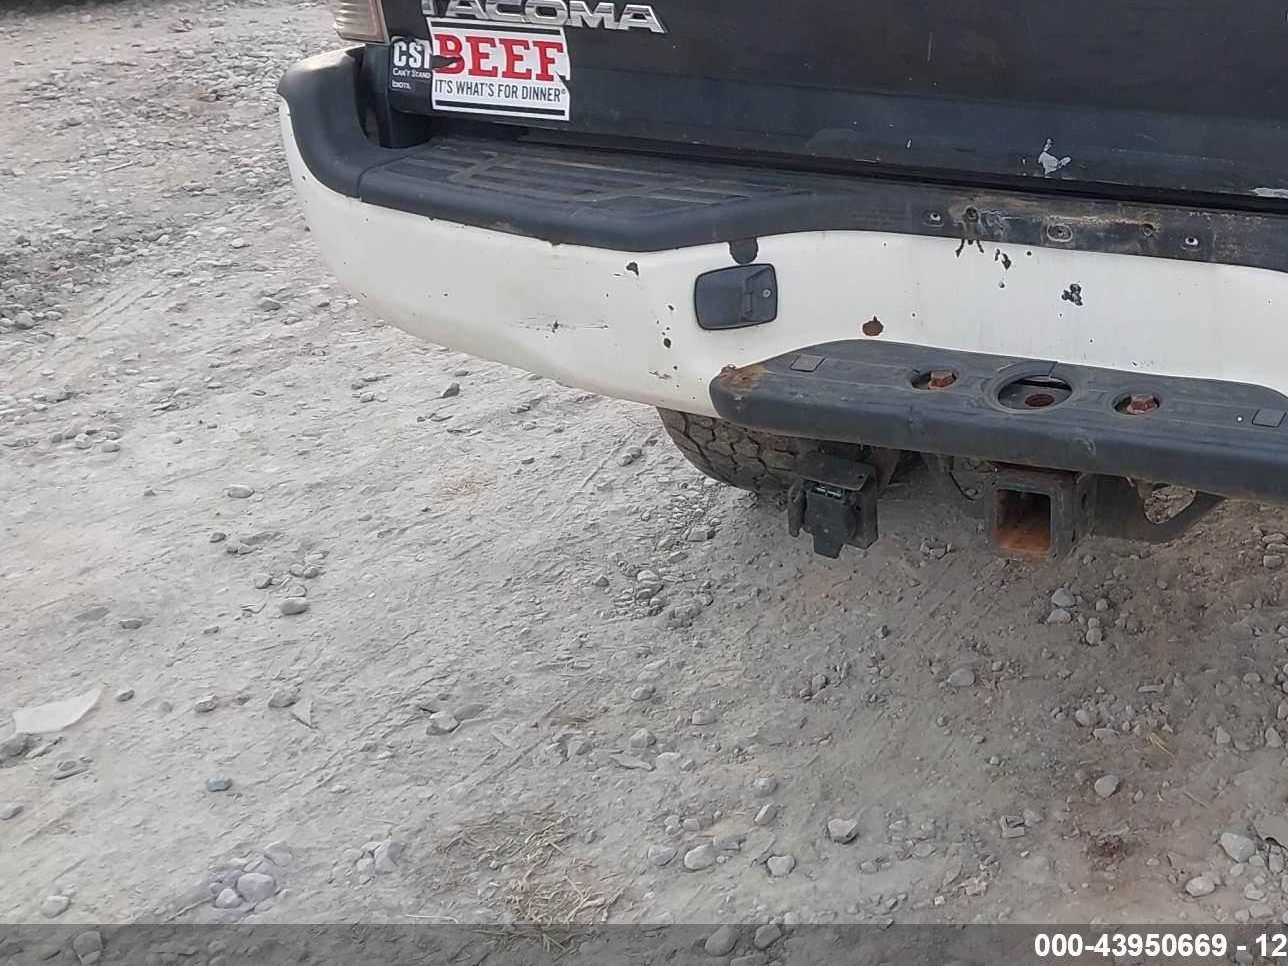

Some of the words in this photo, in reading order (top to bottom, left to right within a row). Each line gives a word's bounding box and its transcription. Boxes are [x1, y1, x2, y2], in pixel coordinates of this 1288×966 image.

[434, 33, 564, 82] BEEF
[434, 79, 453, 94] IT'S
[456, 80, 495, 98] WHAT'S
[497, 84, 519, 99] FOR
